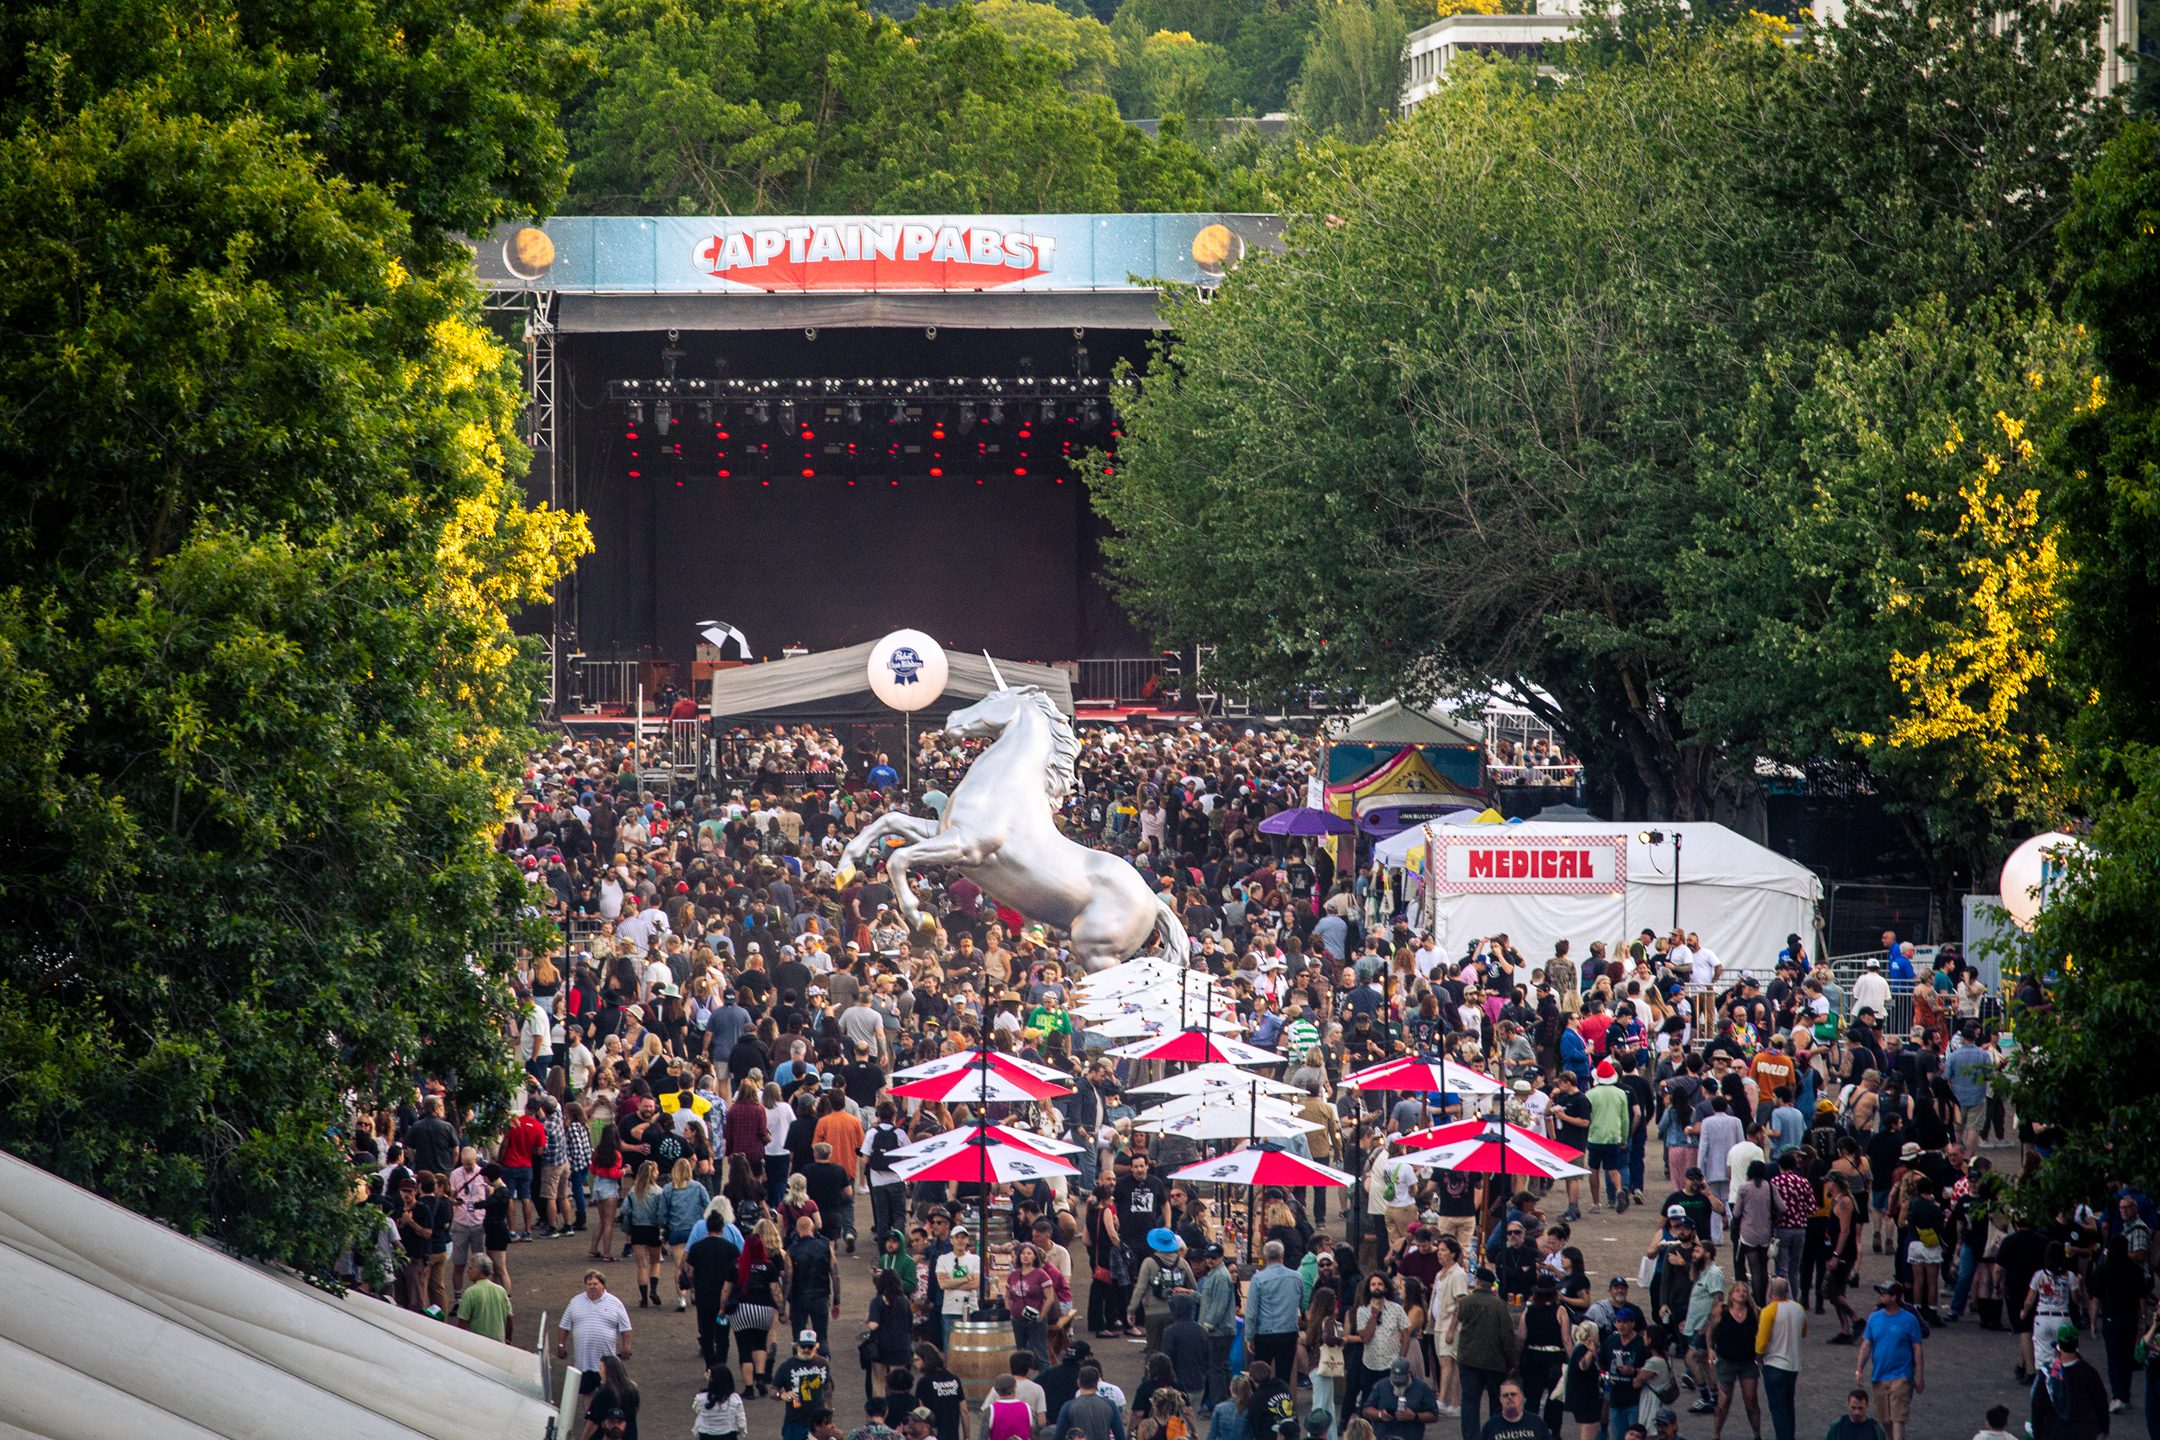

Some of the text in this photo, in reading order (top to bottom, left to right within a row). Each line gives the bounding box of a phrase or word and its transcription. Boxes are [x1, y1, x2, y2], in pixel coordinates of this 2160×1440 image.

[690, 222, 1057, 273] CAPTAIN PABST
[1468, 850, 1594, 879] MEDICAL
